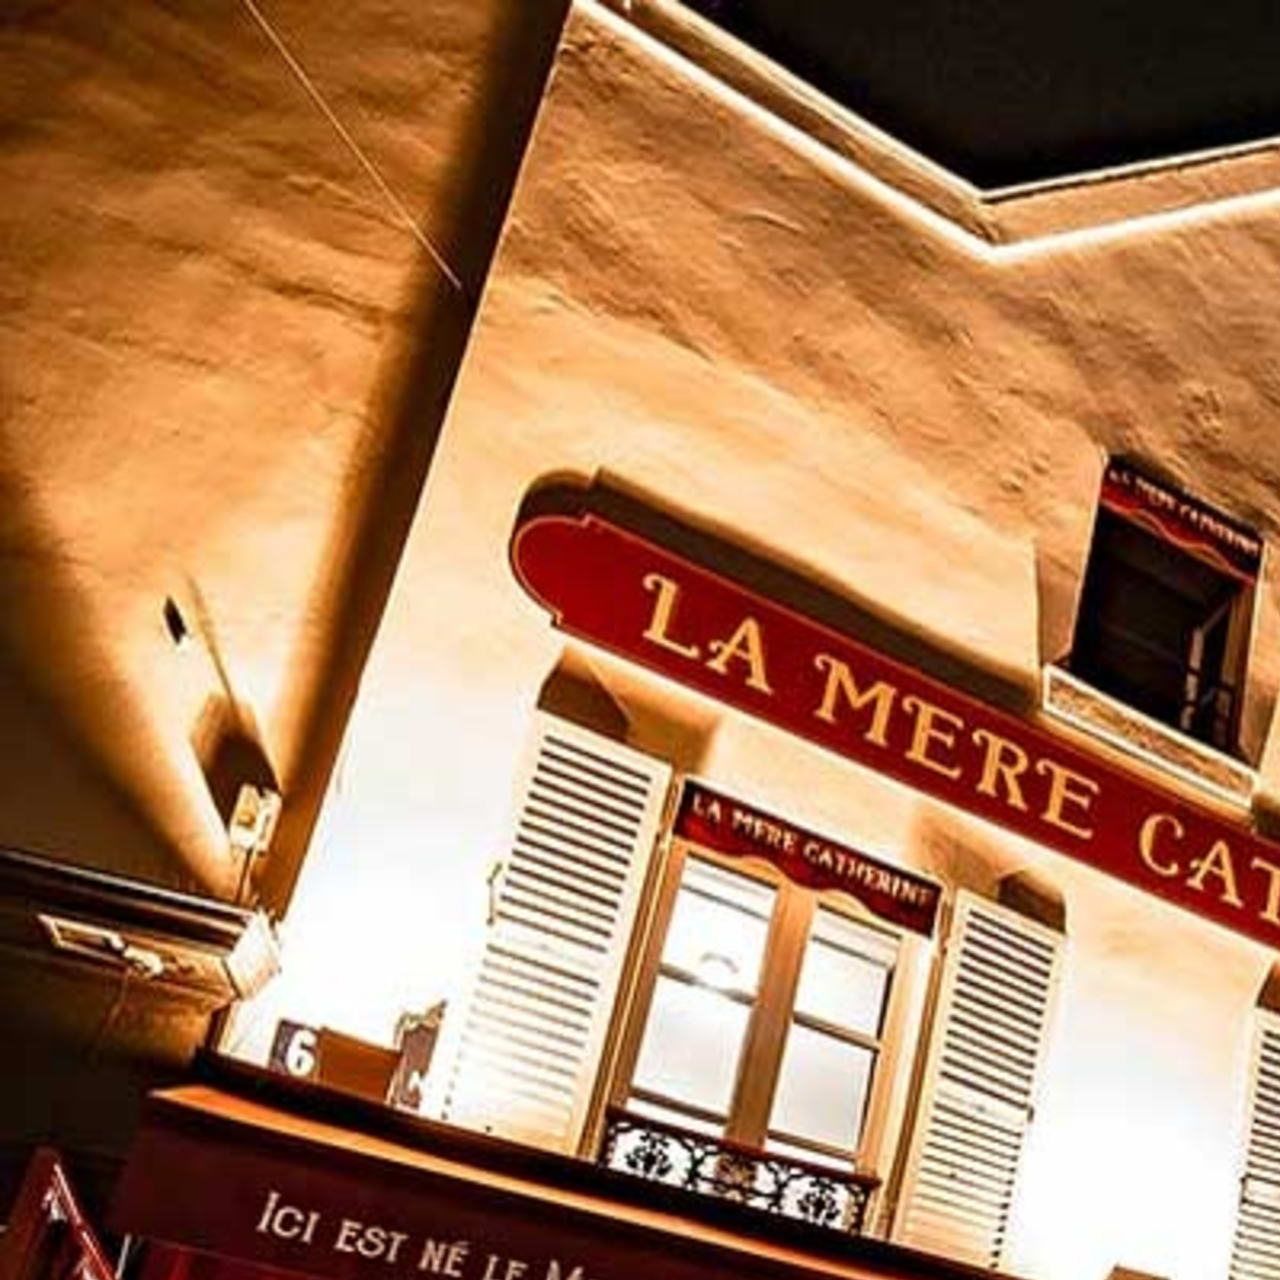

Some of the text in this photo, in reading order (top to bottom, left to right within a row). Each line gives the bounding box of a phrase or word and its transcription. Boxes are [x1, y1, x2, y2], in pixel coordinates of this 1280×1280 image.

[641, 572, 774, 697] LA
[811, 649, 1102, 839] MERE
[692, 792, 722, 822] LA
[731, 808, 798, 852] MERE
[286, 1029, 317, 1077] 6
